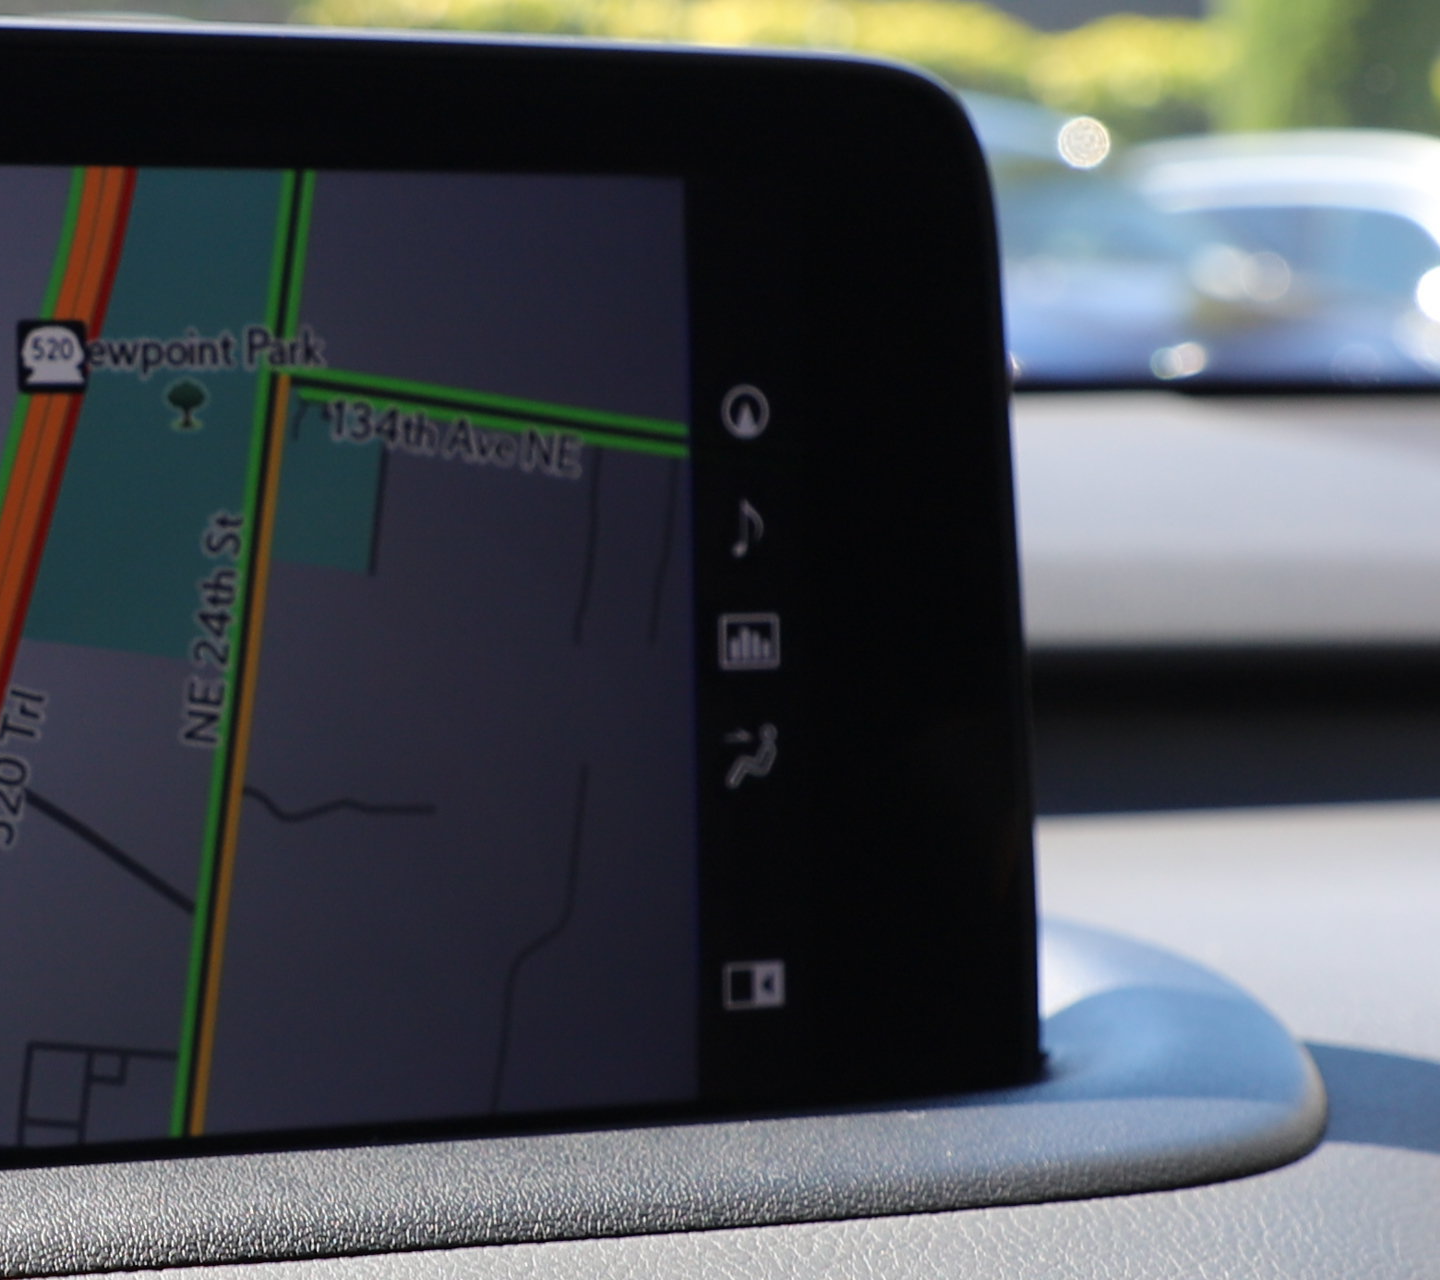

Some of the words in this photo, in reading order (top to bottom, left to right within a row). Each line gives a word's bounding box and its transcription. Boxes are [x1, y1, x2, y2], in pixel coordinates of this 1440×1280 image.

[31, 336, 74, 361] 520
[86, 328, 232, 374] ewpoint
[248, 326, 319, 366] Park
[331, 399, 435, 452] 134th
[444, 417, 515, 463] Ave
[523, 427, 583, 476] NE
[204, 514, 245, 556] St
[193, 570, 237, 665] 24th
[0, 688, 45, 741] Trl
[183, 681, 226, 744] NE
